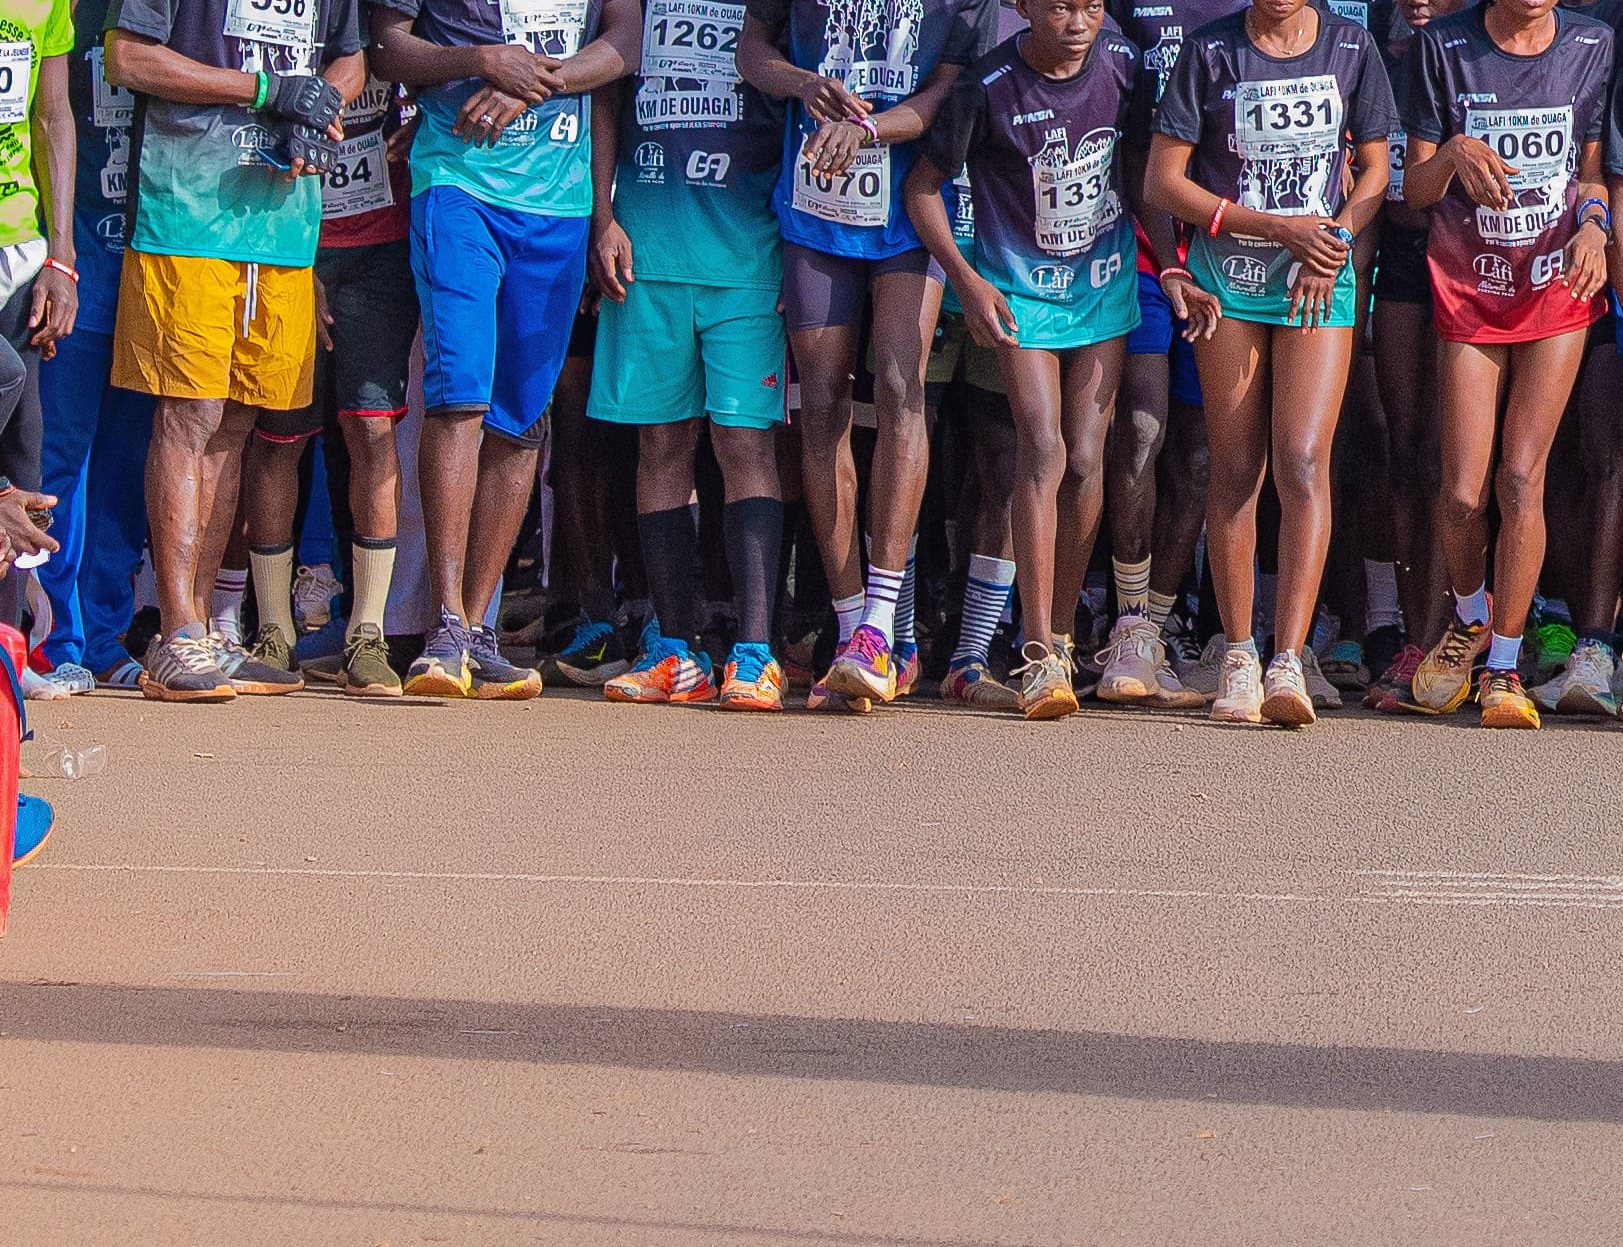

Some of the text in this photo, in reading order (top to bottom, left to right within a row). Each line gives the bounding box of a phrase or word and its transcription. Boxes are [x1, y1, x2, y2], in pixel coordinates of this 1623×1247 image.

[668, 2, 685, 15] LAFI
[687, 4, 708, 17] 10KM
[709, 7, 719, 18] de
[1337, 5, 1363, 18] OUAGA
[653, 18, 739, 53] 1262
[1161, 26, 1182, 38] LAFI
[1260, 84, 1276, 97] LAFI
[1299, 81, 1308, 92] de
[637, 96, 732, 118] KM DE OUAGA
[1247, 98, 1332, 132] 1331
[1488, 112, 1567, 127] LAFI 10KM de OUAGA
[1045, 128, 1066, 140] LAFI
[357, 137, 380, 151] OUAGA
[856, 153, 882, 166] OUAGA
[321, 156, 372, 189] 84
[800, 161, 879, 197] 1070
[1056, 167, 1074, 180] LAFI
[1479, 215, 1500, 234] KM
[1503, 215, 1522, 233] DE
